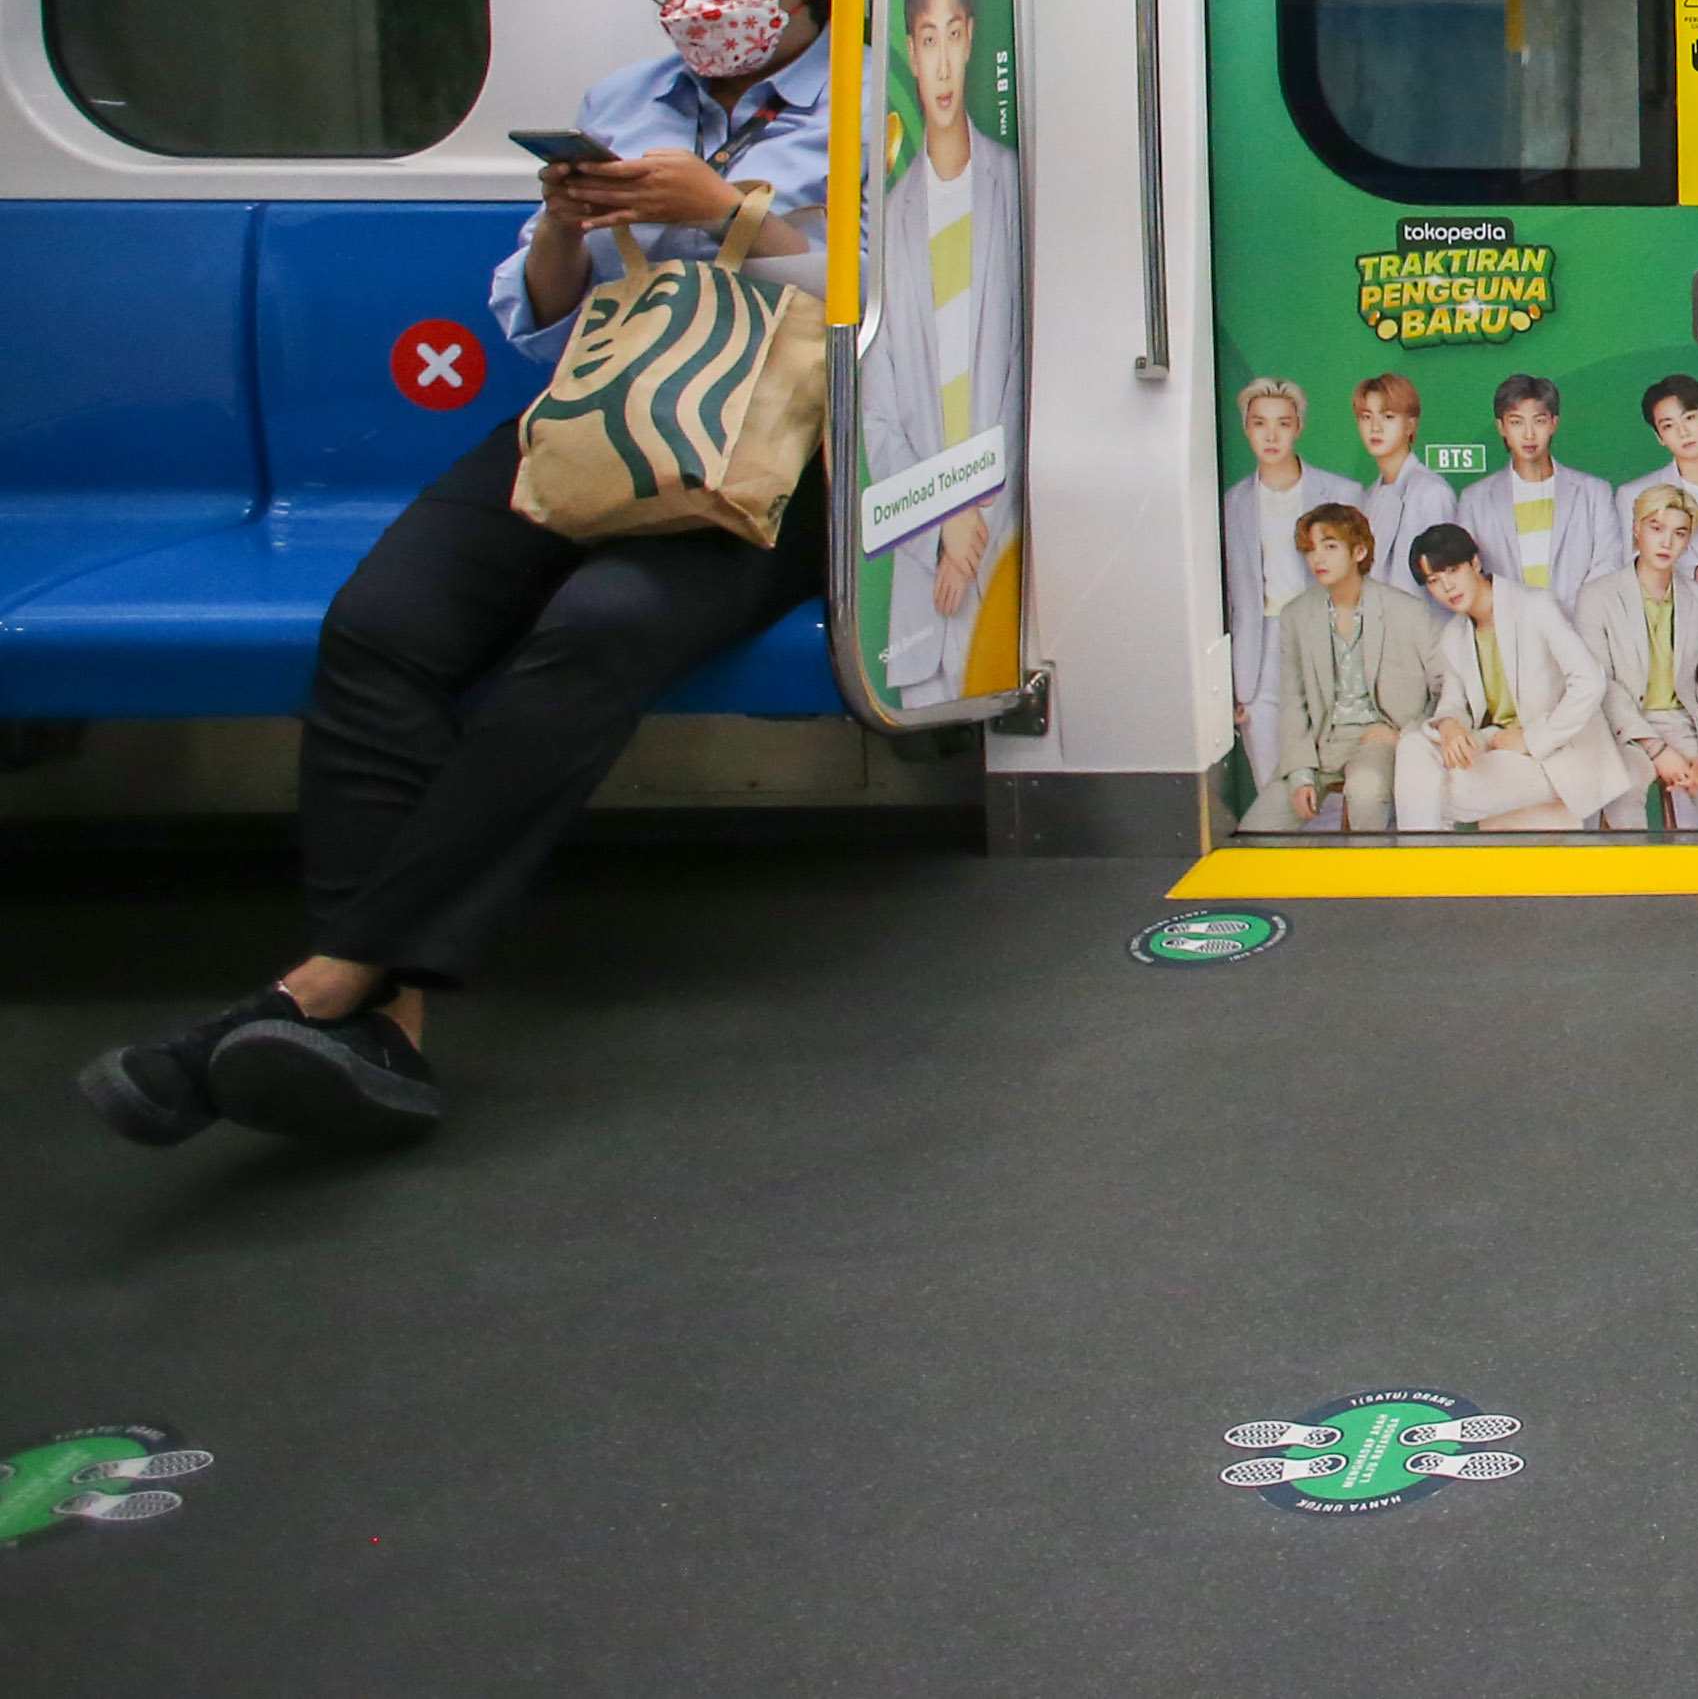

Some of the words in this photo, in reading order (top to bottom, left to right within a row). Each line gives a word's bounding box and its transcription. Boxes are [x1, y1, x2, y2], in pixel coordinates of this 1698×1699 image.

[997, 51, 1008, 92] BTS
[1404, 223, 1506, 244] tokopedia
[1358, 248, 1548, 281] TRAKTIRAN
[1361, 276, 1548, 311] PENGGUNA
[1401, 306, 1511, 339] BARU
[1438, 448, 1472, 468] BTS
[873, 477, 935, 525] Download
[938, 450, 996, 492] Tokopedia
[1412, 1392, 1456, 1407] ORANG
[1295, 1498, 1344, 1513] UNTUK
[1350, 1494, 1402, 1512] HANYA
